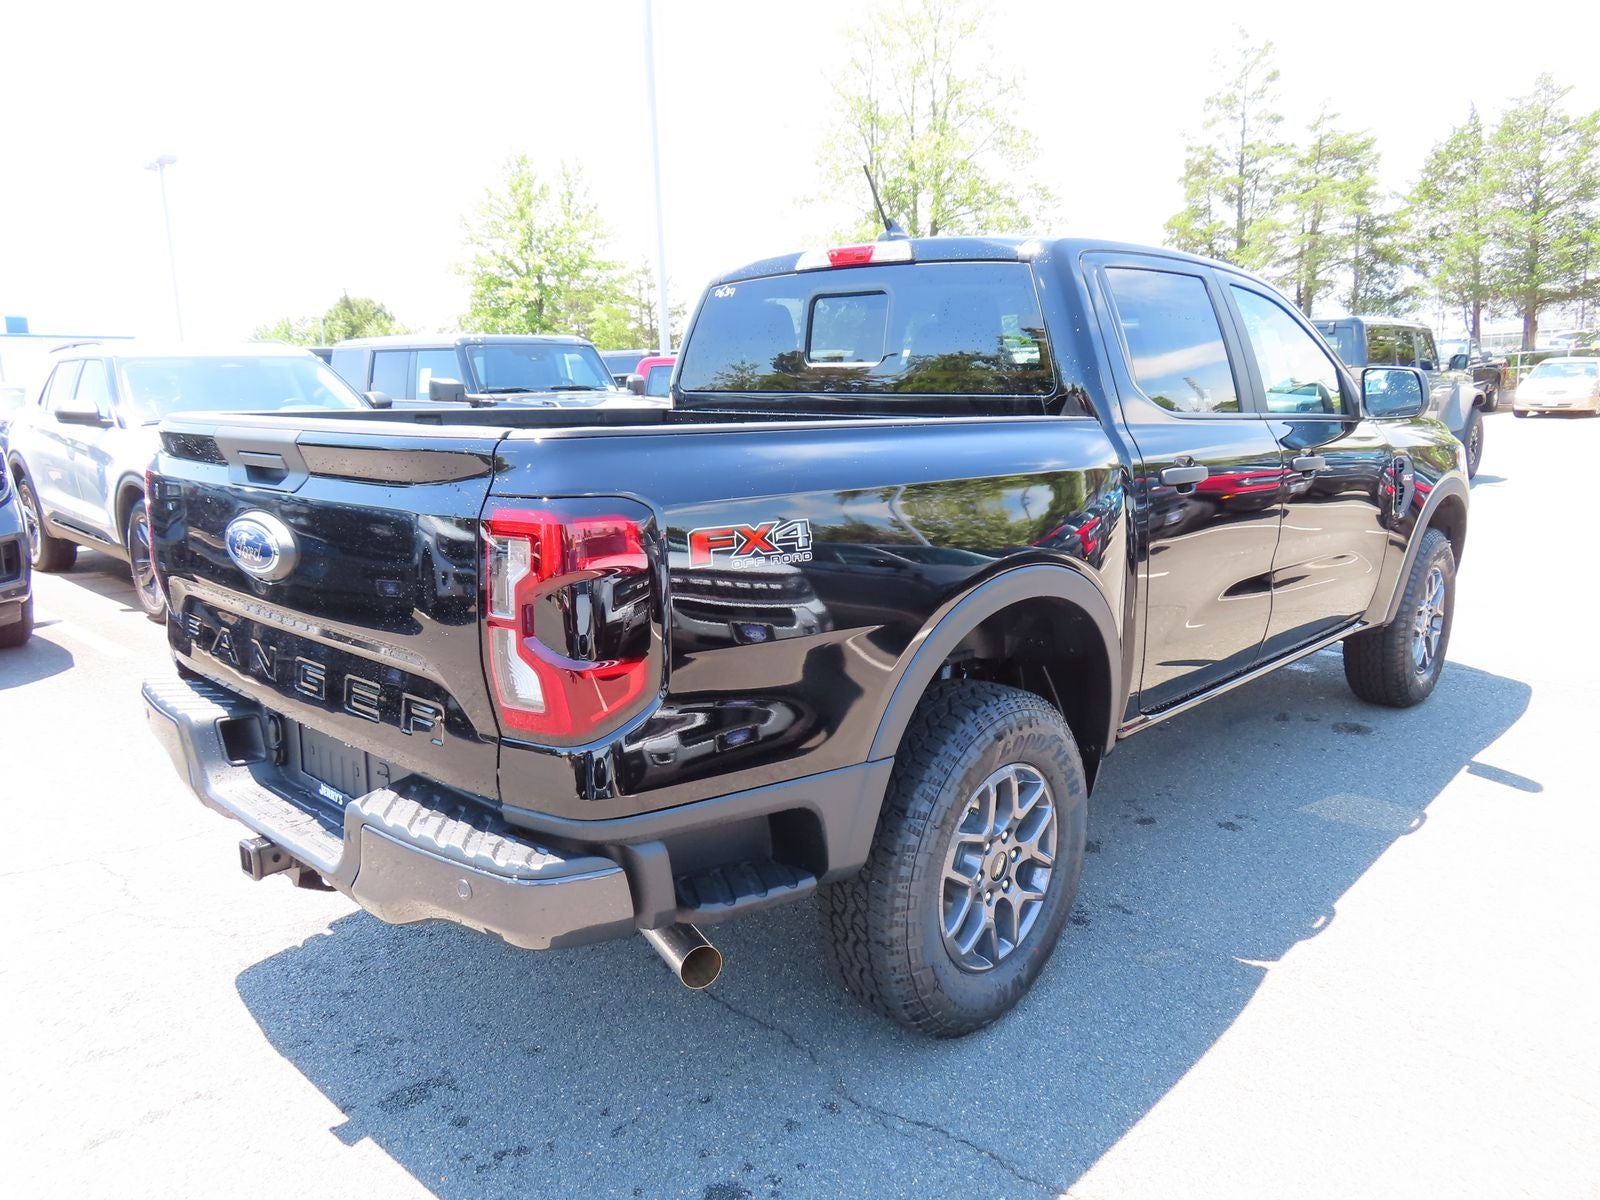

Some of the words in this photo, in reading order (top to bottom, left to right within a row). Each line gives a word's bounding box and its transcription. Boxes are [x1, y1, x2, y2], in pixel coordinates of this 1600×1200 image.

[235, 532, 263, 562] Ford
[687, 518, 812, 569] FX4
[732, 556, 766, 569] OFF
[770, 551, 813, 565] ROAD
[182, 611, 444, 746] RANGER
